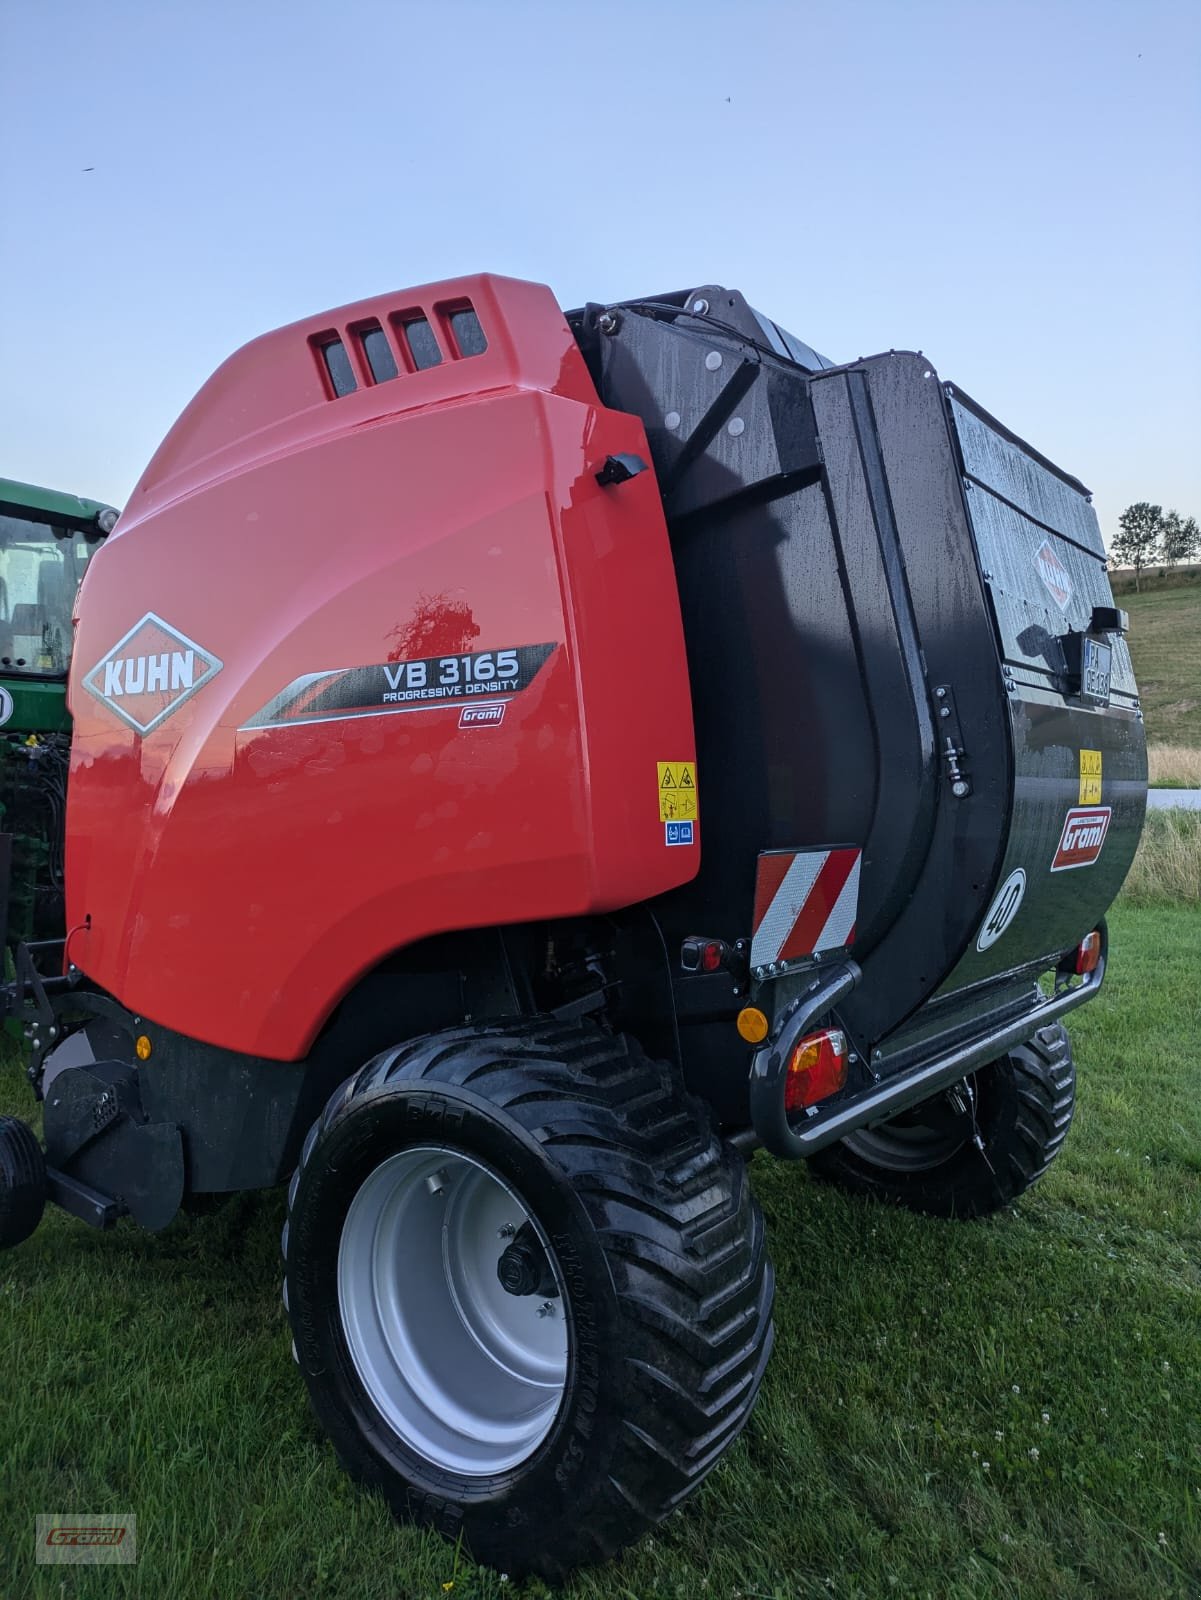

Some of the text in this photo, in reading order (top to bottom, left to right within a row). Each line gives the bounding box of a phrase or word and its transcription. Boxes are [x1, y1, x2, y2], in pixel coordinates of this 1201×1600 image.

[104, 650, 194, 697] KUHN
[383, 650, 519, 690] VB 3165
[383, 680, 519, 703] PROGRESSIVE DENSITY
[463, 706, 503, 721] Graml
[1062, 815, 1108, 852] Graml
[986, 883, 1021, 937] 40
